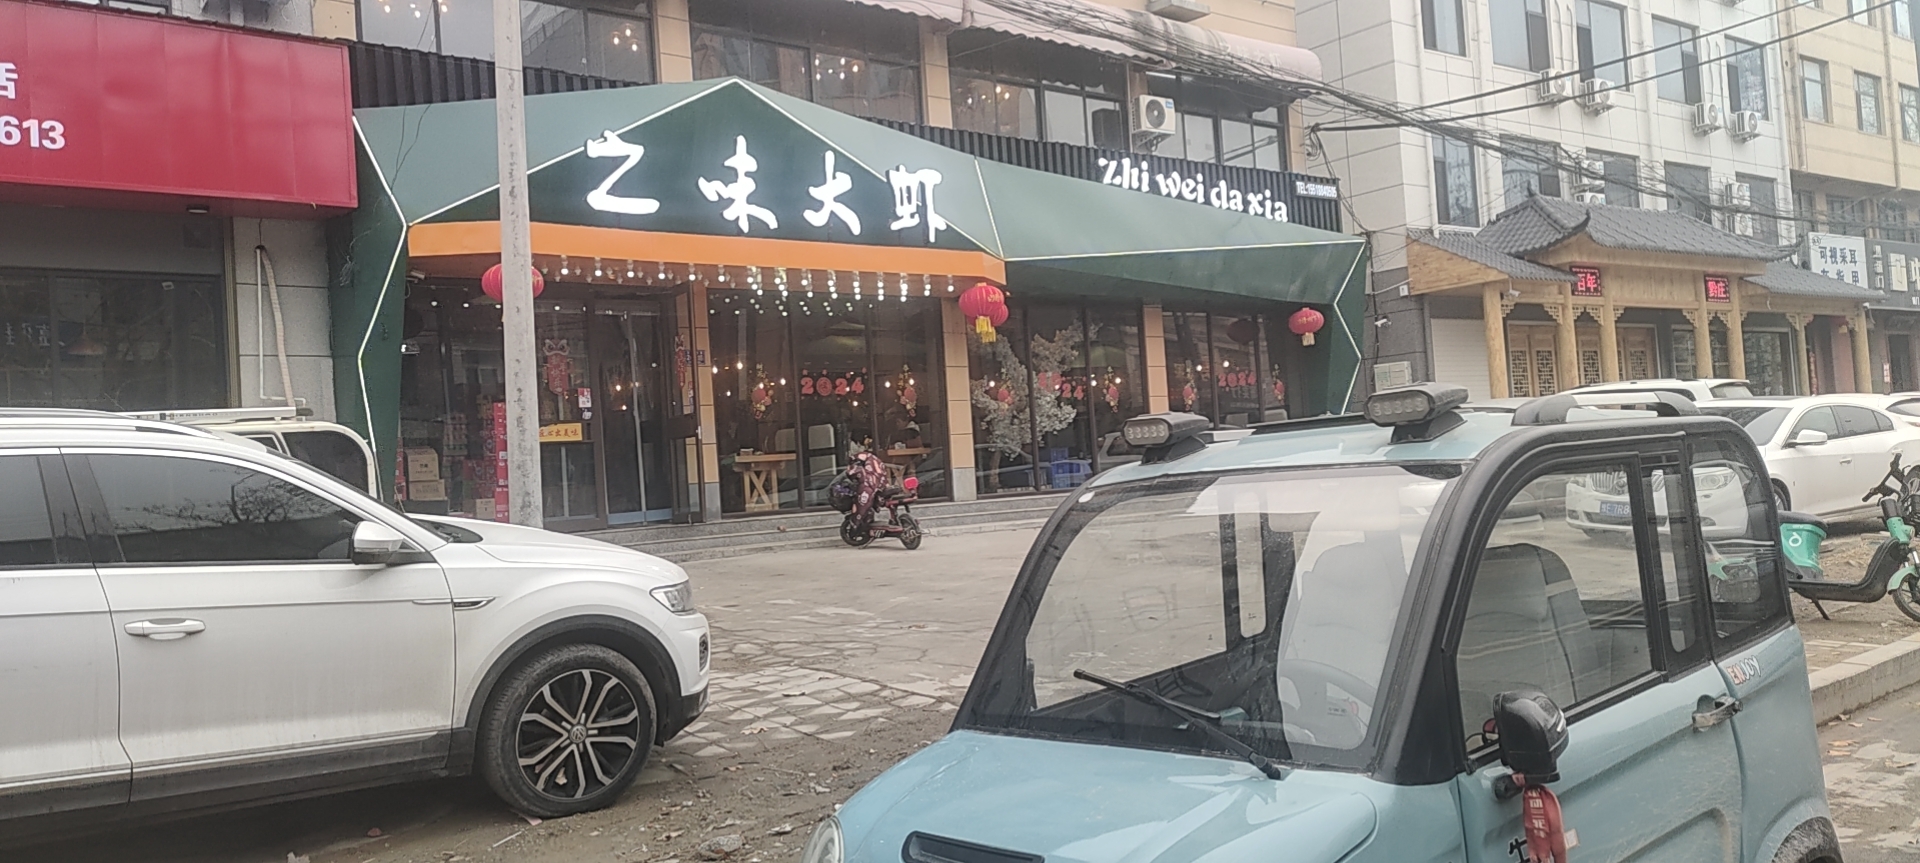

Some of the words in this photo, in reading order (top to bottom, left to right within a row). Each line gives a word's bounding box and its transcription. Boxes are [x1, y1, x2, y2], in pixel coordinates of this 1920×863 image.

[0, 115, 66, 150] 613
[586, 130, 947, 243] 之味大虾
[1098, 157, 1150, 193] Zhi
[1156, 171, 1205, 204] wei
[1210, 179, 1244, 212] da
[1248, 189, 1289, 223] xia
[1577, 273, 1598, 293] 百年
[800, 377, 865, 397] 2024
[1726, 655, 1762, 685] ENJOY
